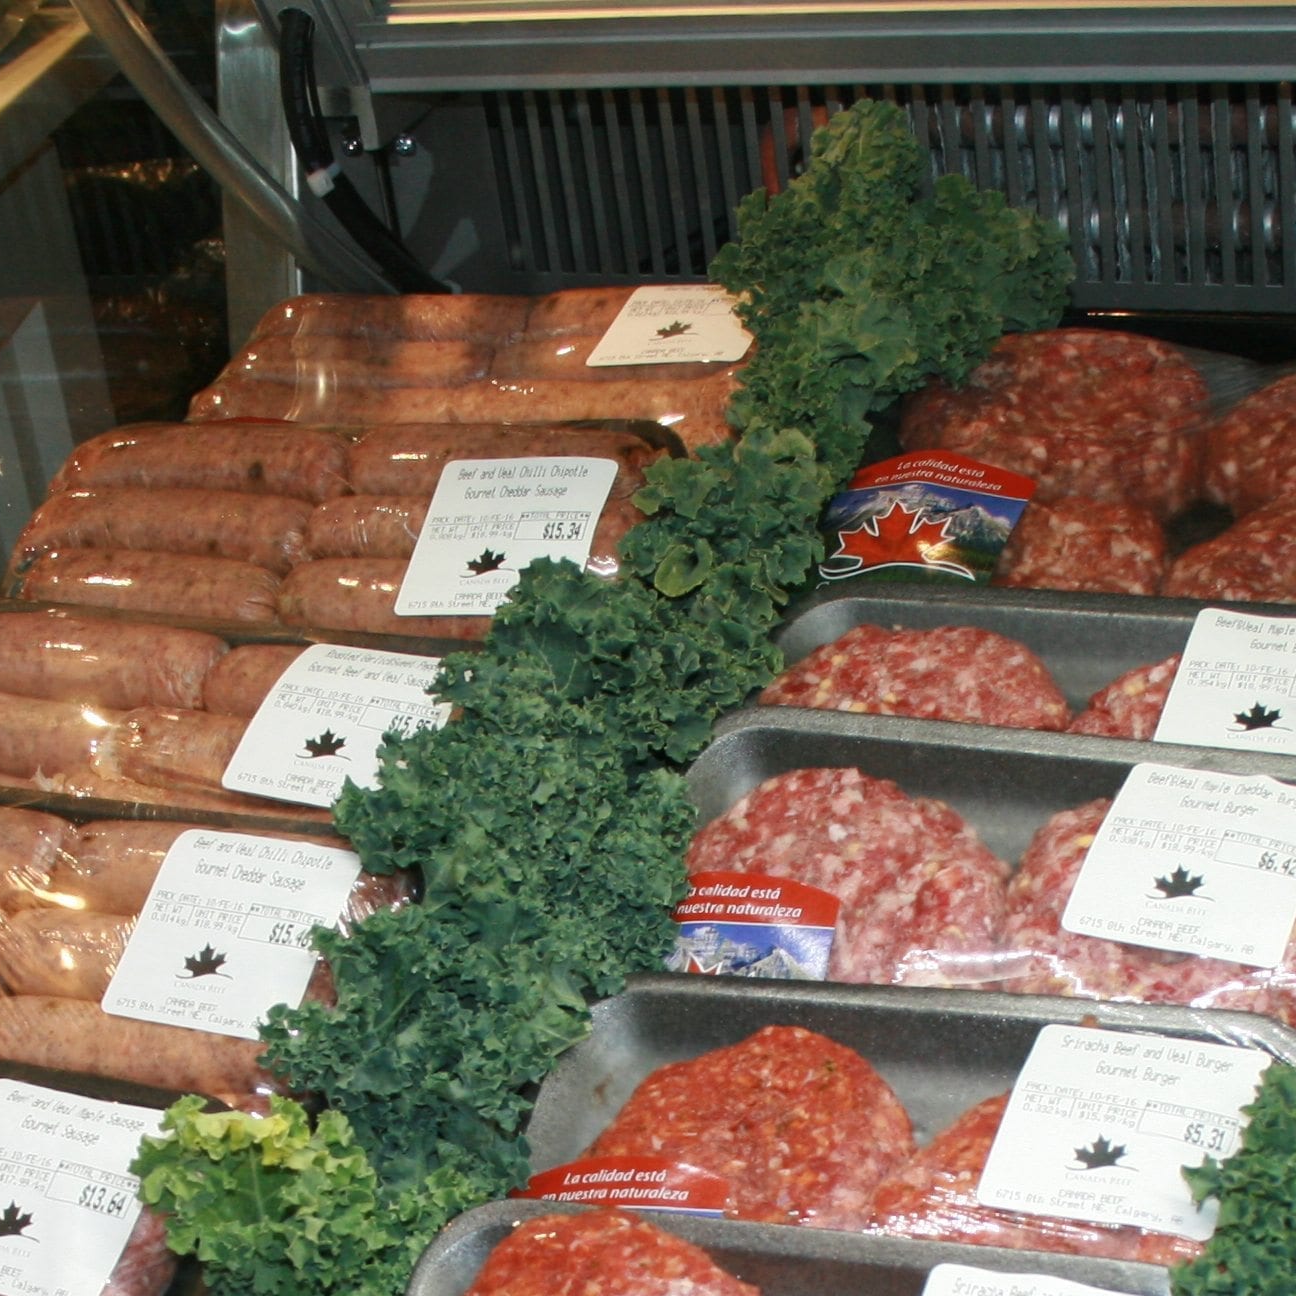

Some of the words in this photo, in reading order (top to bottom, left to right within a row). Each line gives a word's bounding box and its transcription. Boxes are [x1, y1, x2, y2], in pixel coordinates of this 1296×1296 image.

[897, 461, 911, 470] La
[912, 459, 959, 471] calidad
[959, 466, 985, 477] está
[890, 469, 934, 481] nuestra
[935, 472, 1002, 491] naturaleza
[543, 522, 580, 539] $15.34
[699, 884, 748, 897] calidad
[751, 888, 781, 899] está
[677, 901, 723, 914] nuestra
[726, 902, 802, 918] naturaleza
[1184, 1123, 1226, 1150] $5.31
[563, 1173, 580, 1185] La
[582, 1169, 634, 1183] calidad
[636, 1170, 666, 1182] está
[79, 1185, 125, 1215] $13.64
[558, 1187, 607, 1201] nuestra
[609, 1186, 689, 1200] naturaleza
